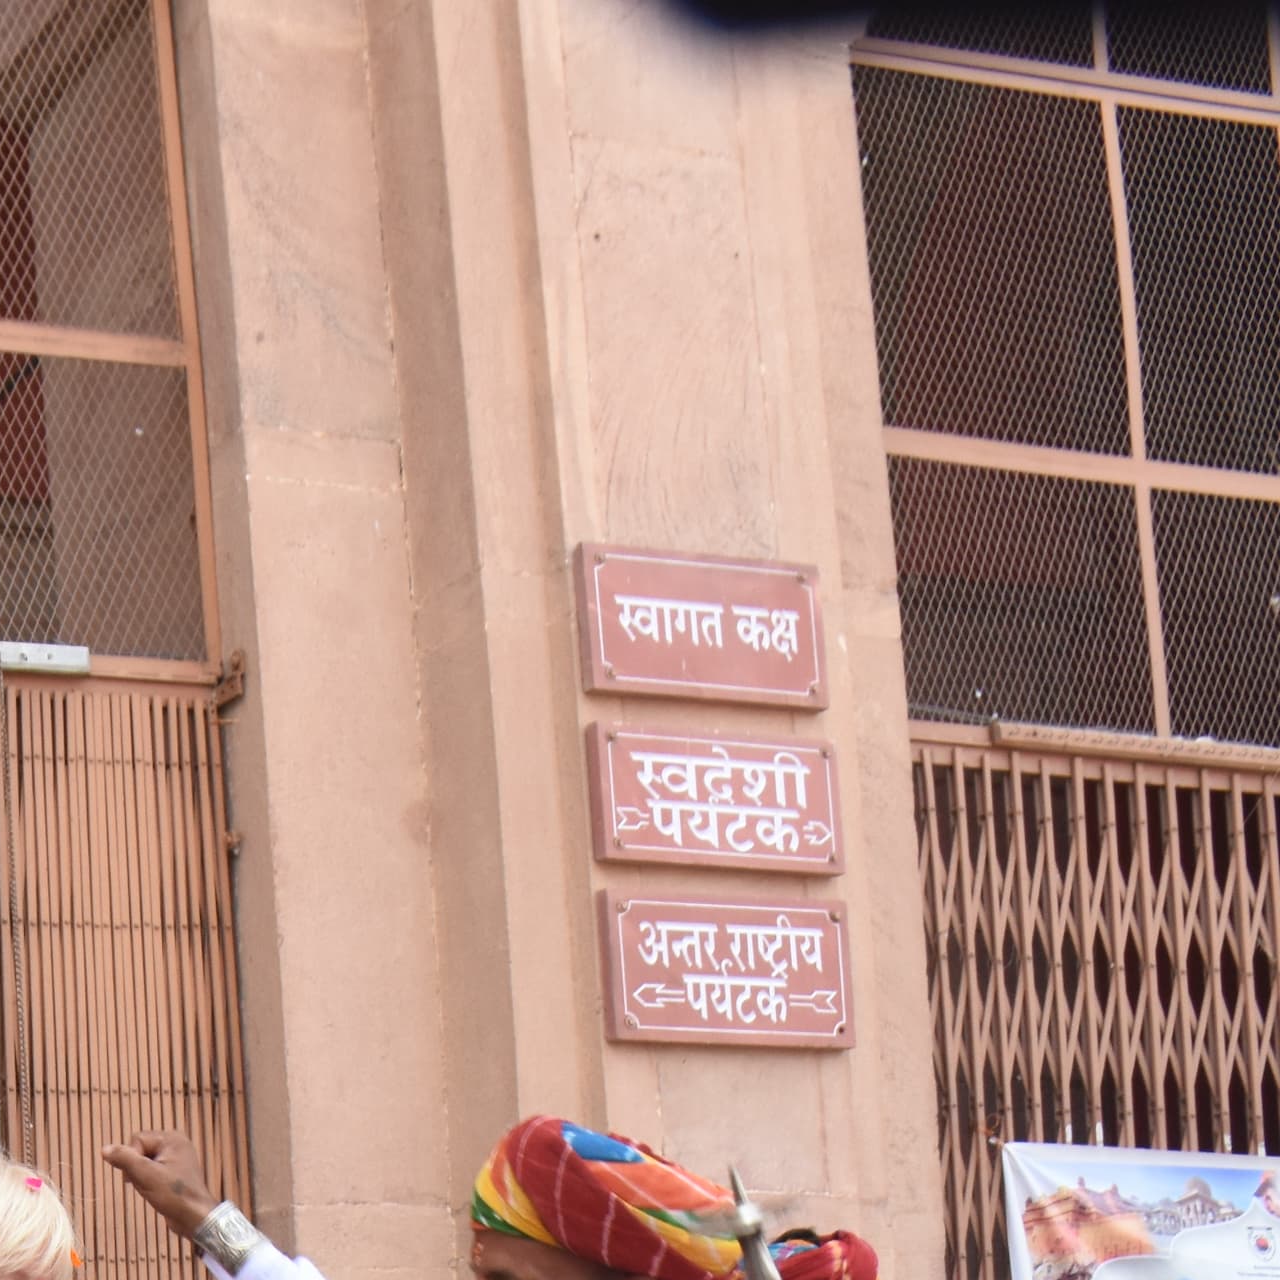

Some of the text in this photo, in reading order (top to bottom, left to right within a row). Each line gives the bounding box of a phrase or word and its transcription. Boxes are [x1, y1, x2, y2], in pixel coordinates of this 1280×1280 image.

[613, 594, 800, 663] स्वागत कक्ष
[629, 745, 811, 810] स्वदेशी
[637, 913, 825, 980] अन्तर राष्ट्रीय
[682, 957, 789, 1025] पर्यटक
